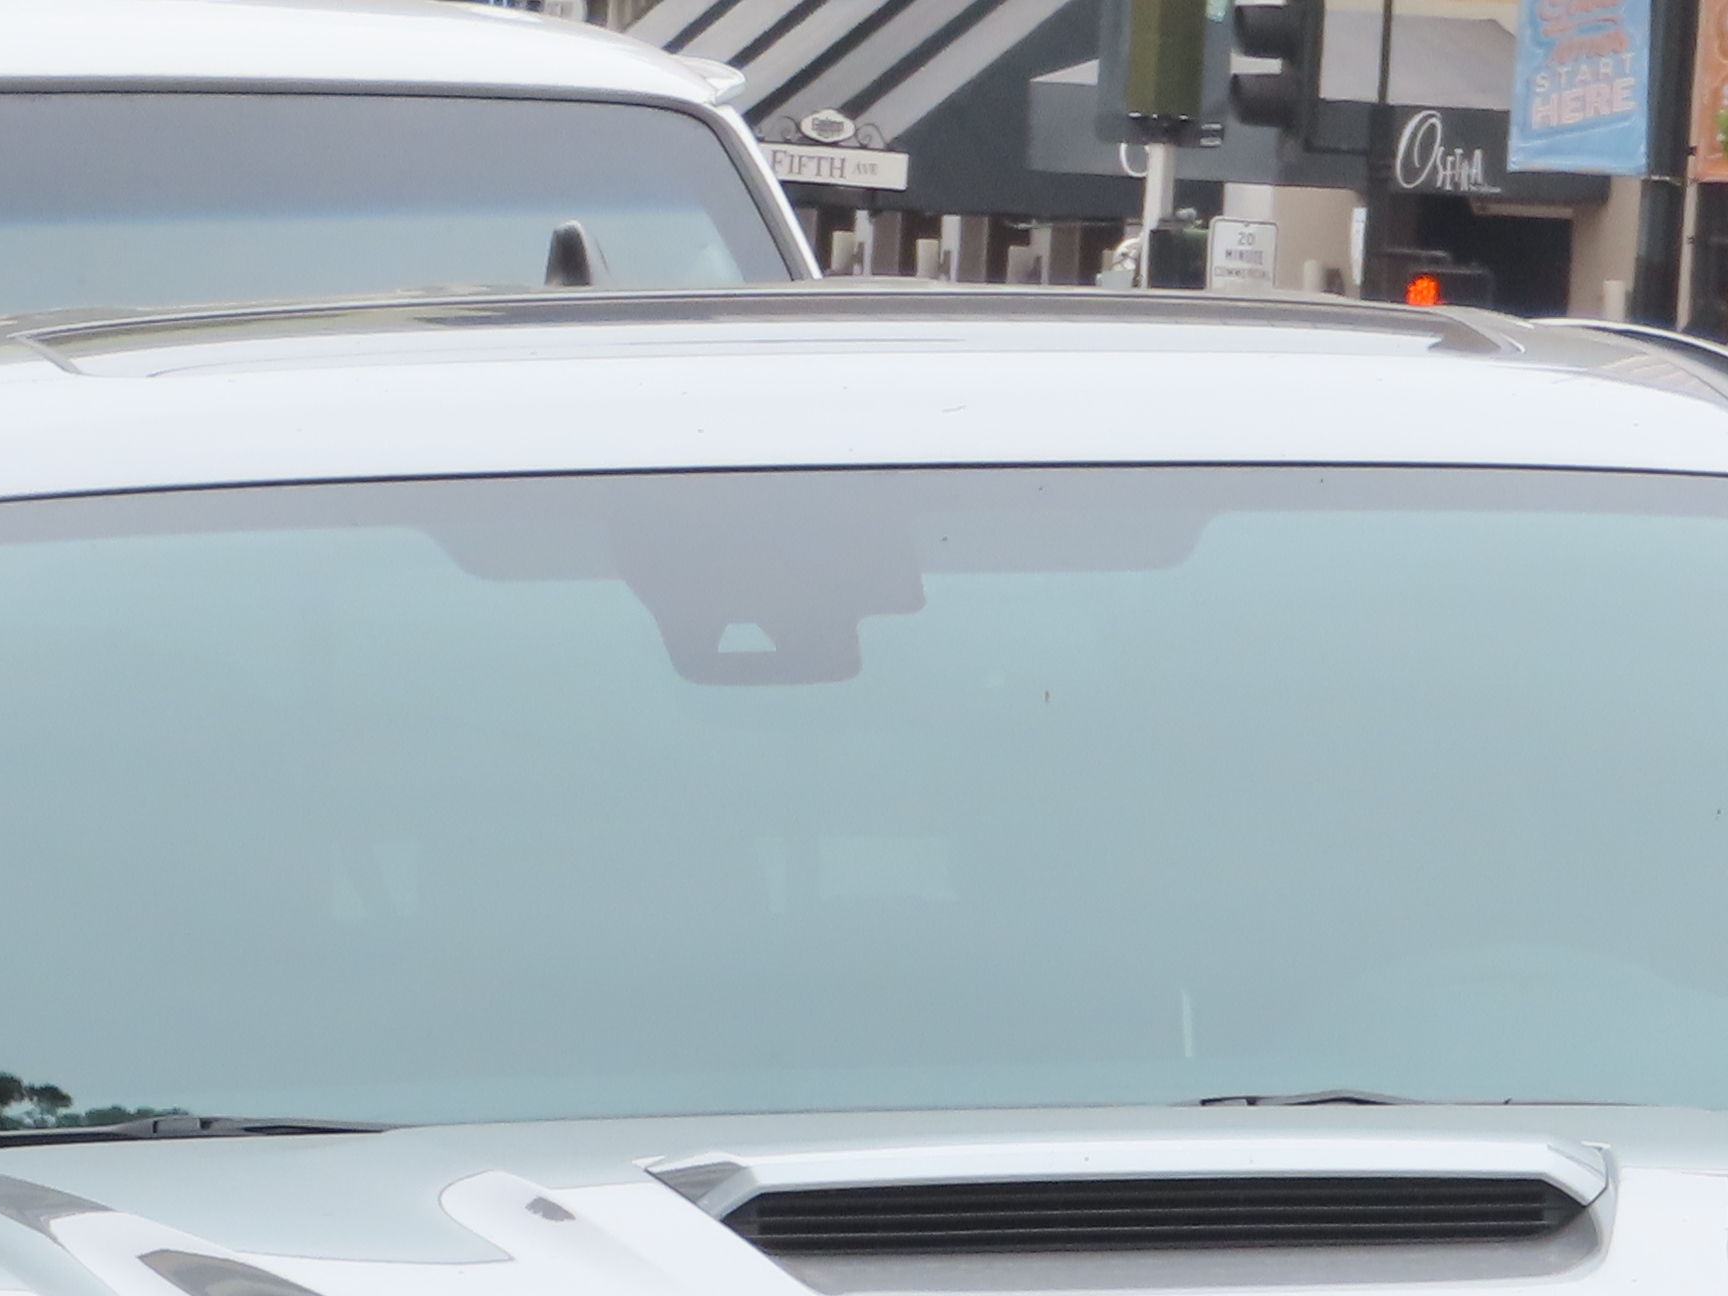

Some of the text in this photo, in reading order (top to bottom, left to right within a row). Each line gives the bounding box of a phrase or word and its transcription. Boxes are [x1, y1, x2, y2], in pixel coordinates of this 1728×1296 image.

[1535, 52, 1636, 93] START
[1531, 77, 1637, 130] HERE
[772, 150, 879, 179] FIFTH AVE
[1238, 232, 1256, 246] 20
